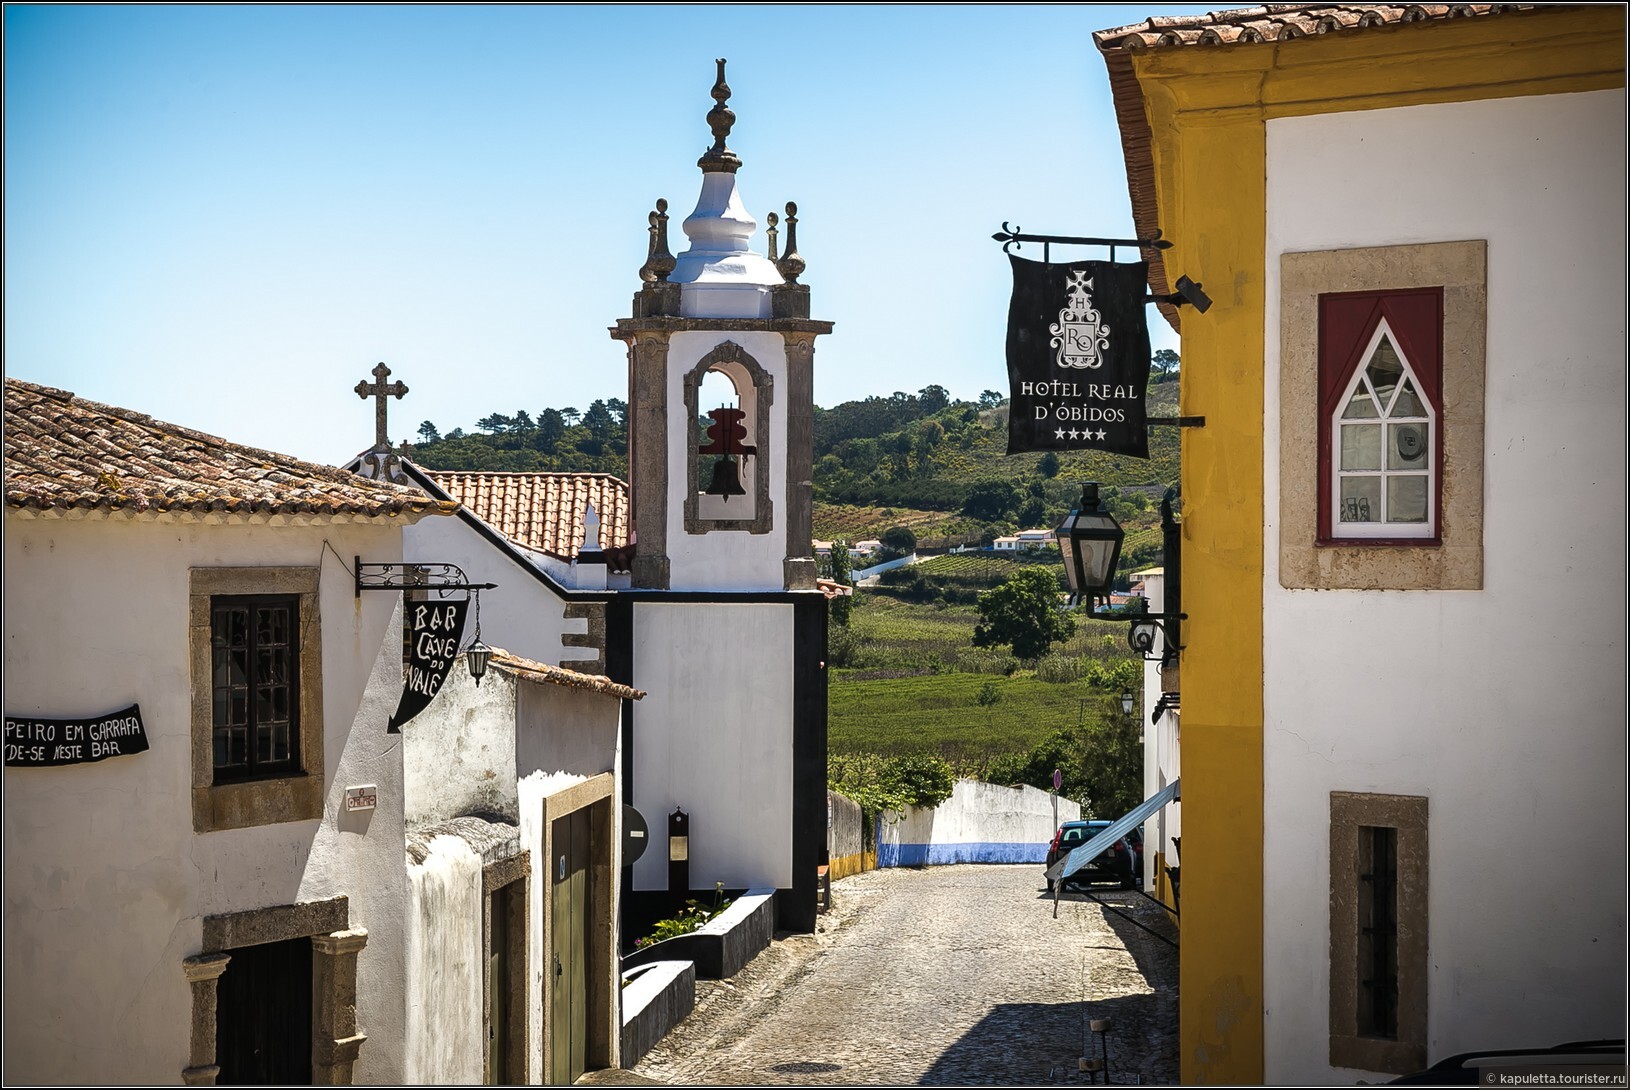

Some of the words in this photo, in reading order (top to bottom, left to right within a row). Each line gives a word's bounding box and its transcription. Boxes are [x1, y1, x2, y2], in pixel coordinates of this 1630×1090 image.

[1075, 298, 1085, 309] H
[1020, 379, 1082, 397] HOTEL
[1088, 384, 1138, 400] REAL
[1035, 401, 1125, 423] D'ÓBIDOS
[414, 604, 457, 632] BAR
[416, 632, 456, 660] CAVE
[430, 660, 444, 670] DO
[408, 664, 441, 697] VALE
[65, 725, 84, 741] EM
[89, 717, 140, 741] GARRAFA
[53, 744, 83, 760] NESTE
[91, 741, 121, 757] BAR
